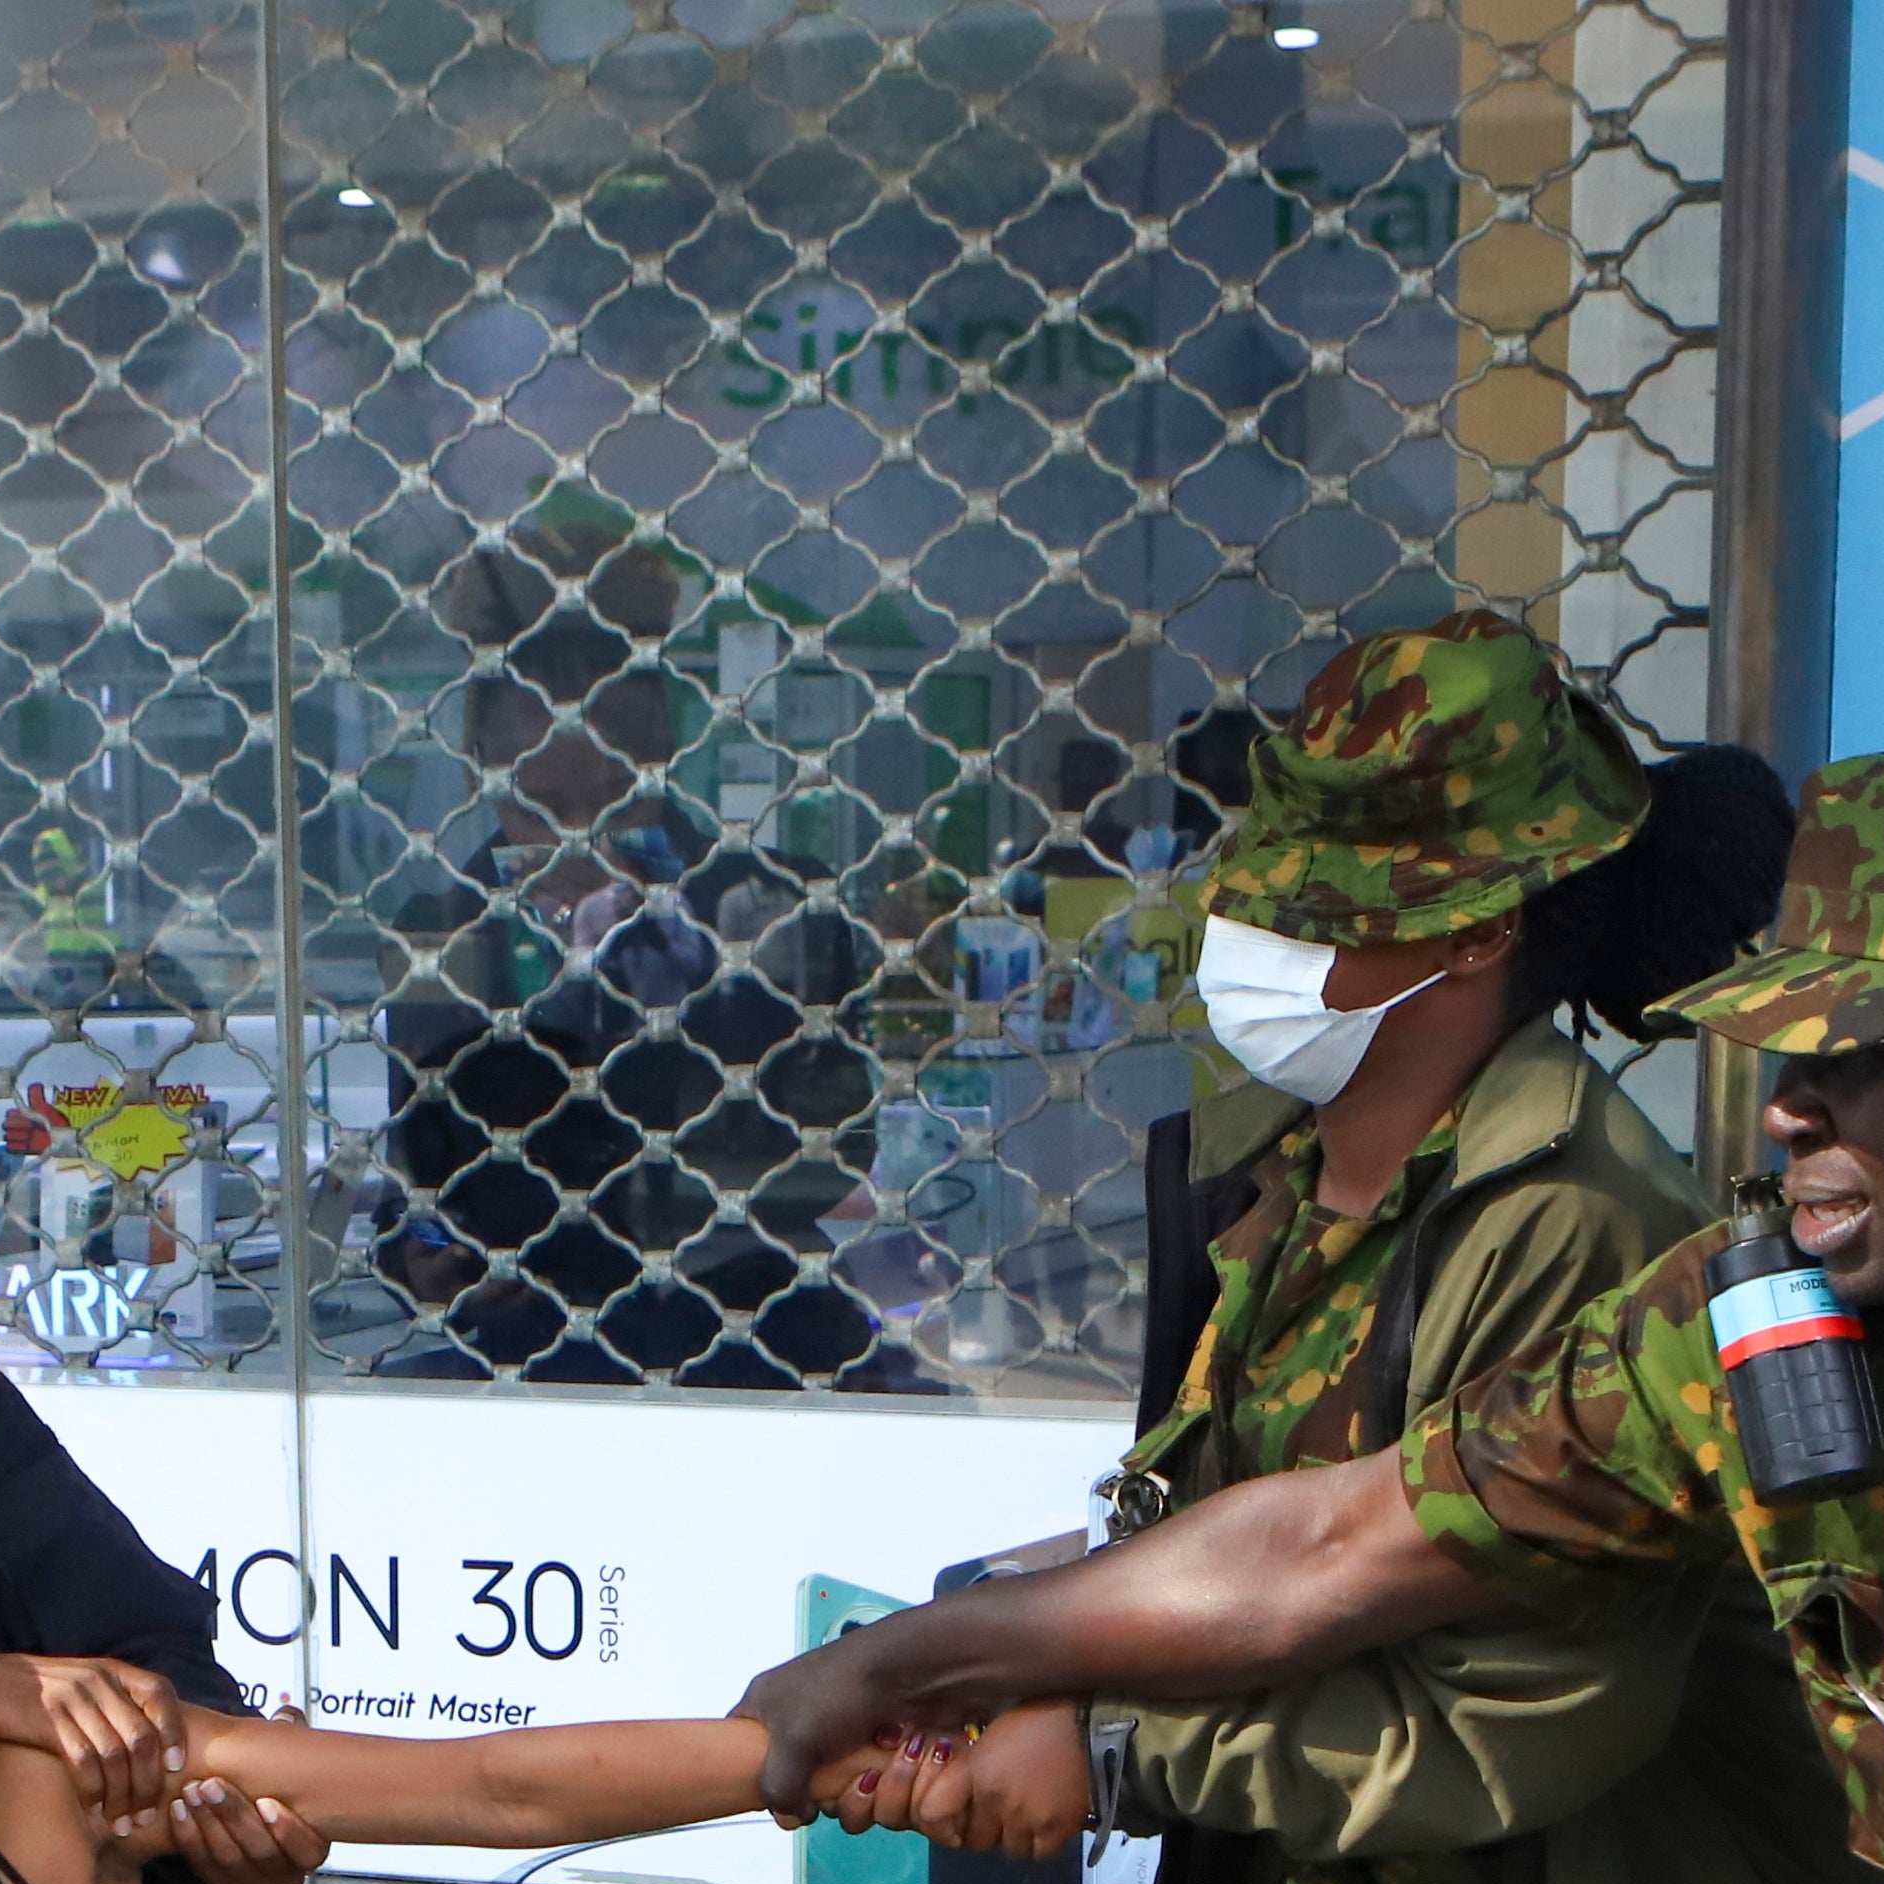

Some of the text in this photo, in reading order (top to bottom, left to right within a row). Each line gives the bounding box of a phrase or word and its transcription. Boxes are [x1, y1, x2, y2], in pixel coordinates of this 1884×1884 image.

[54, 1087, 106, 1106] NEW
[454, 1559, 584, 1661] 30
[598, 1564, 626, 1664] Series
[308, 1686, 416, 1719] Portrait
[428, 1692, 537, 1726] Master
